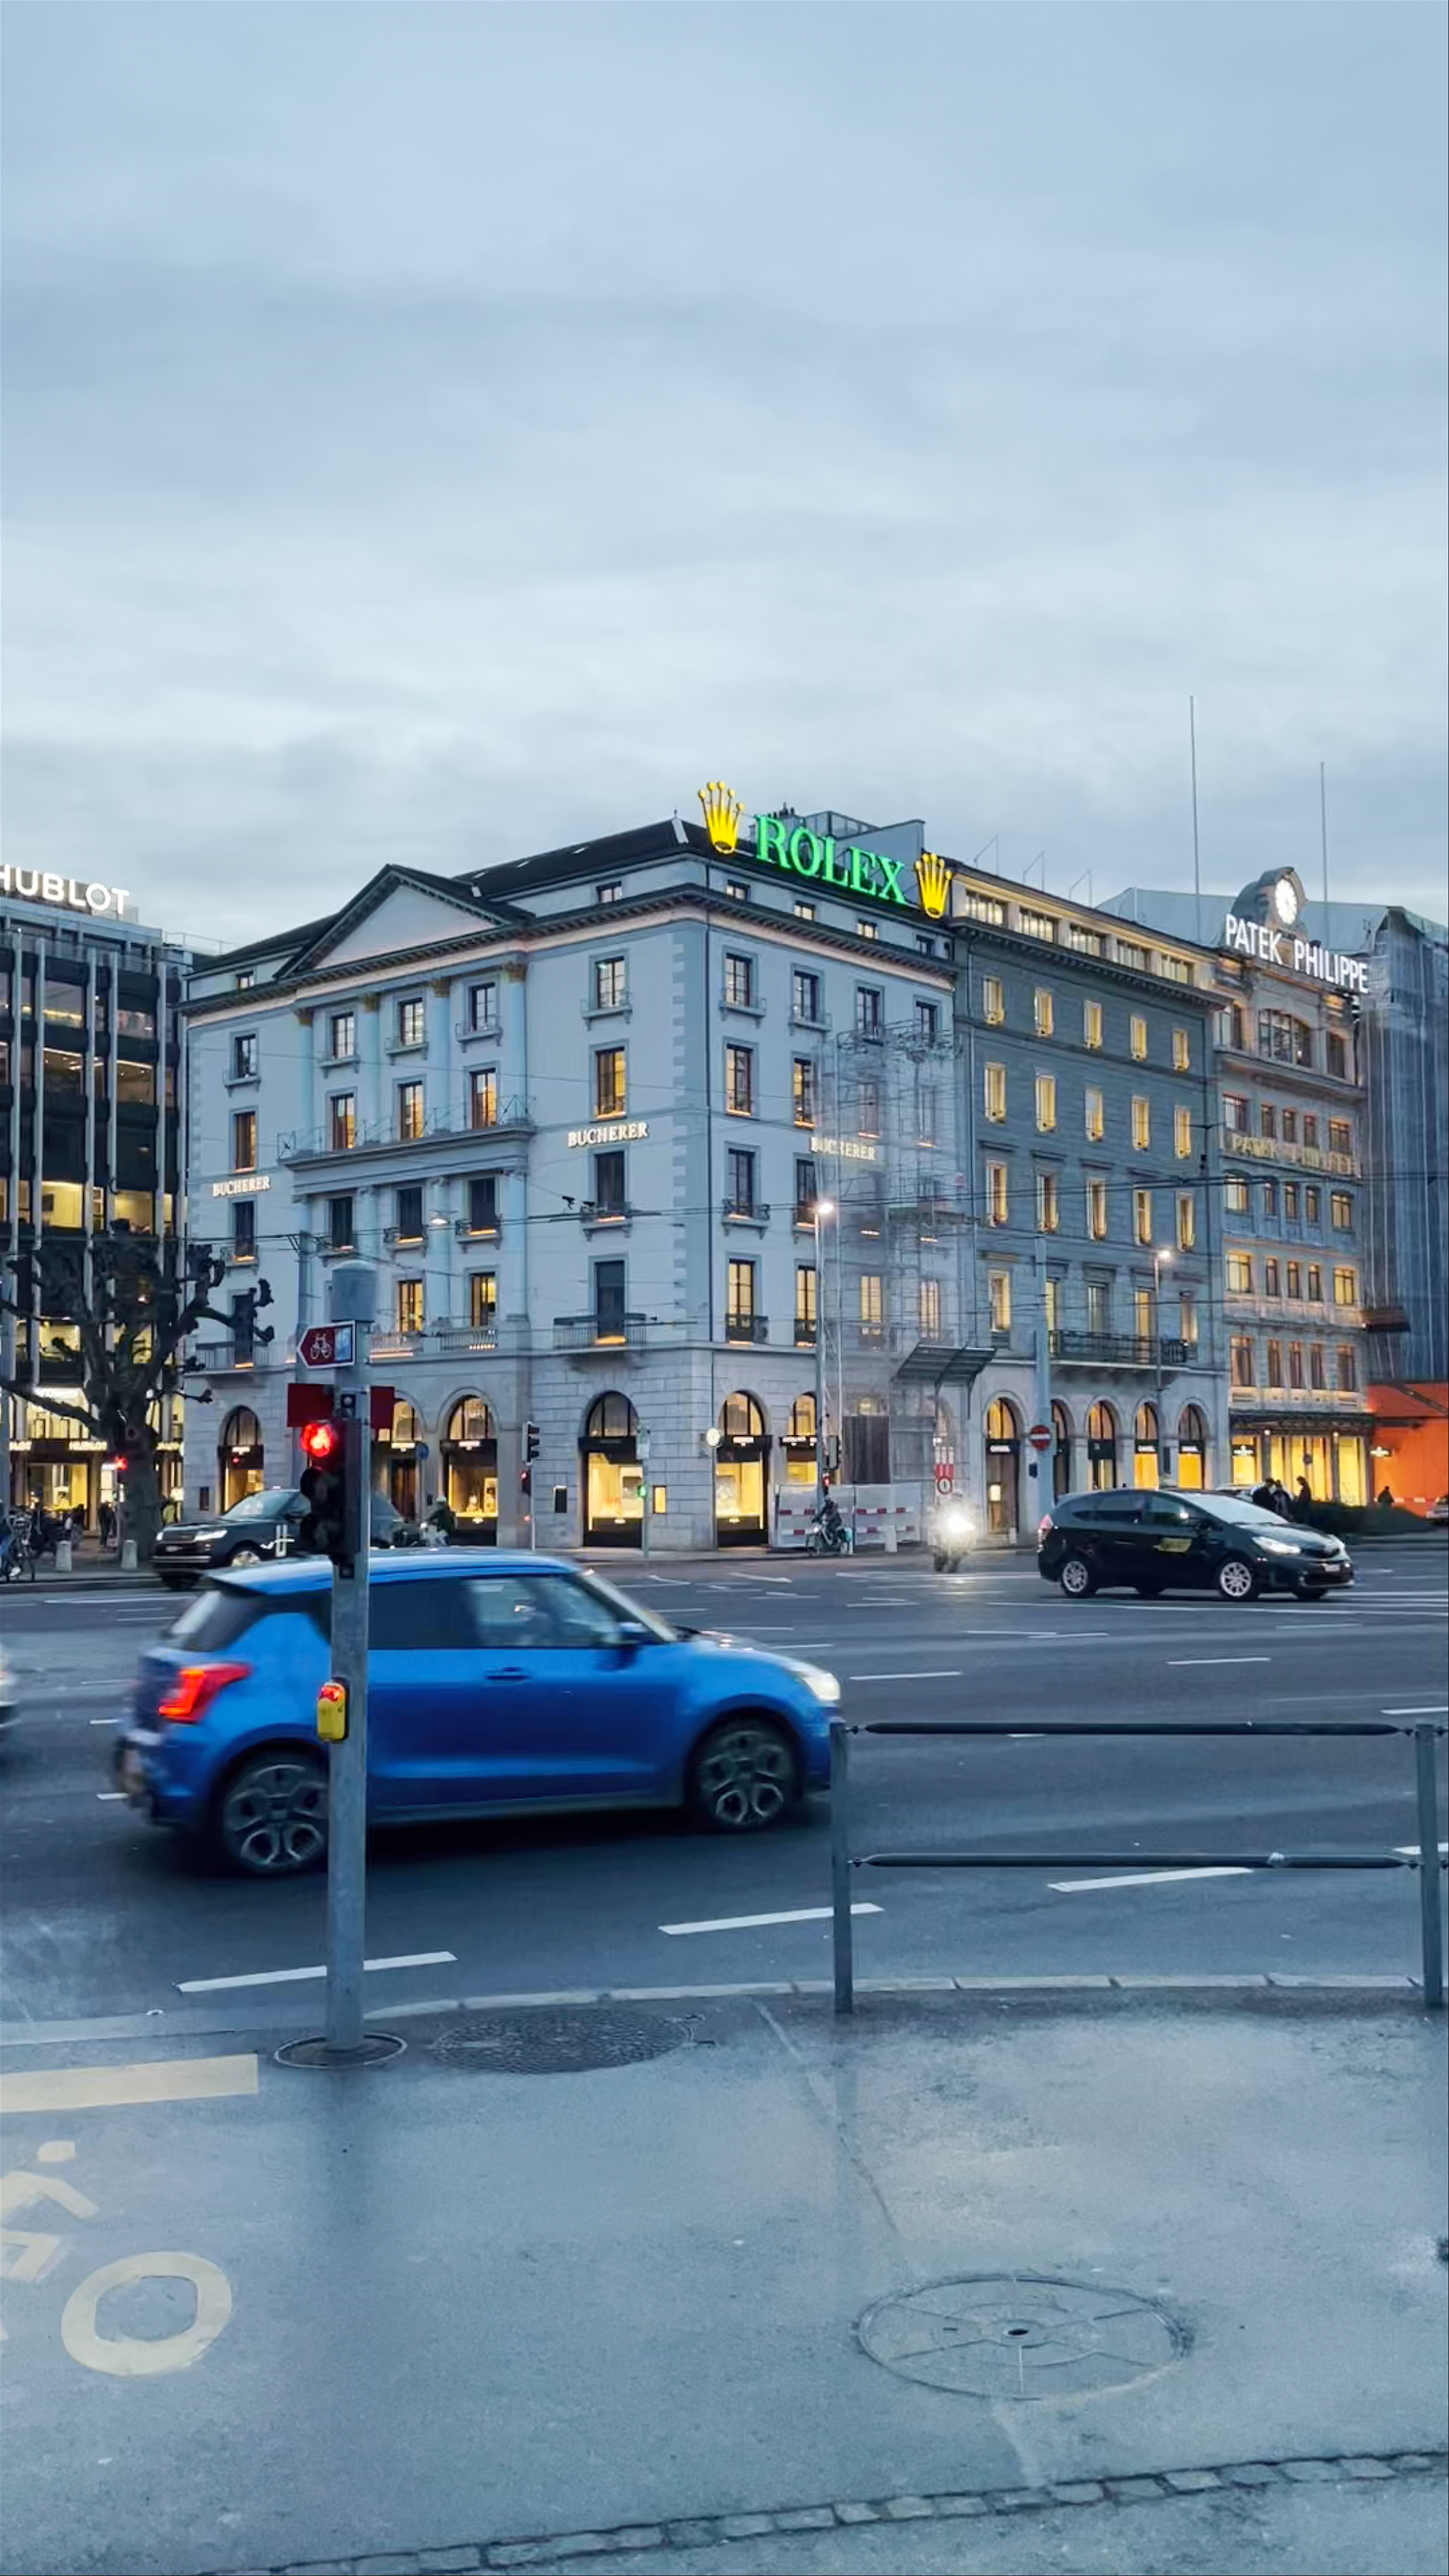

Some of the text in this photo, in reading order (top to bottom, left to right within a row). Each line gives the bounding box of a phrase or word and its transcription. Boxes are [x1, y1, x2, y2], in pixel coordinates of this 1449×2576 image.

[754, 815, 906, 904] ROLEX
[1225, 914, 1368, 993] PATEK PHILIPPE
[568, 1122, 648, 1147] BUCHERER
[212, 1176, 270, 1196] BUCHERER
